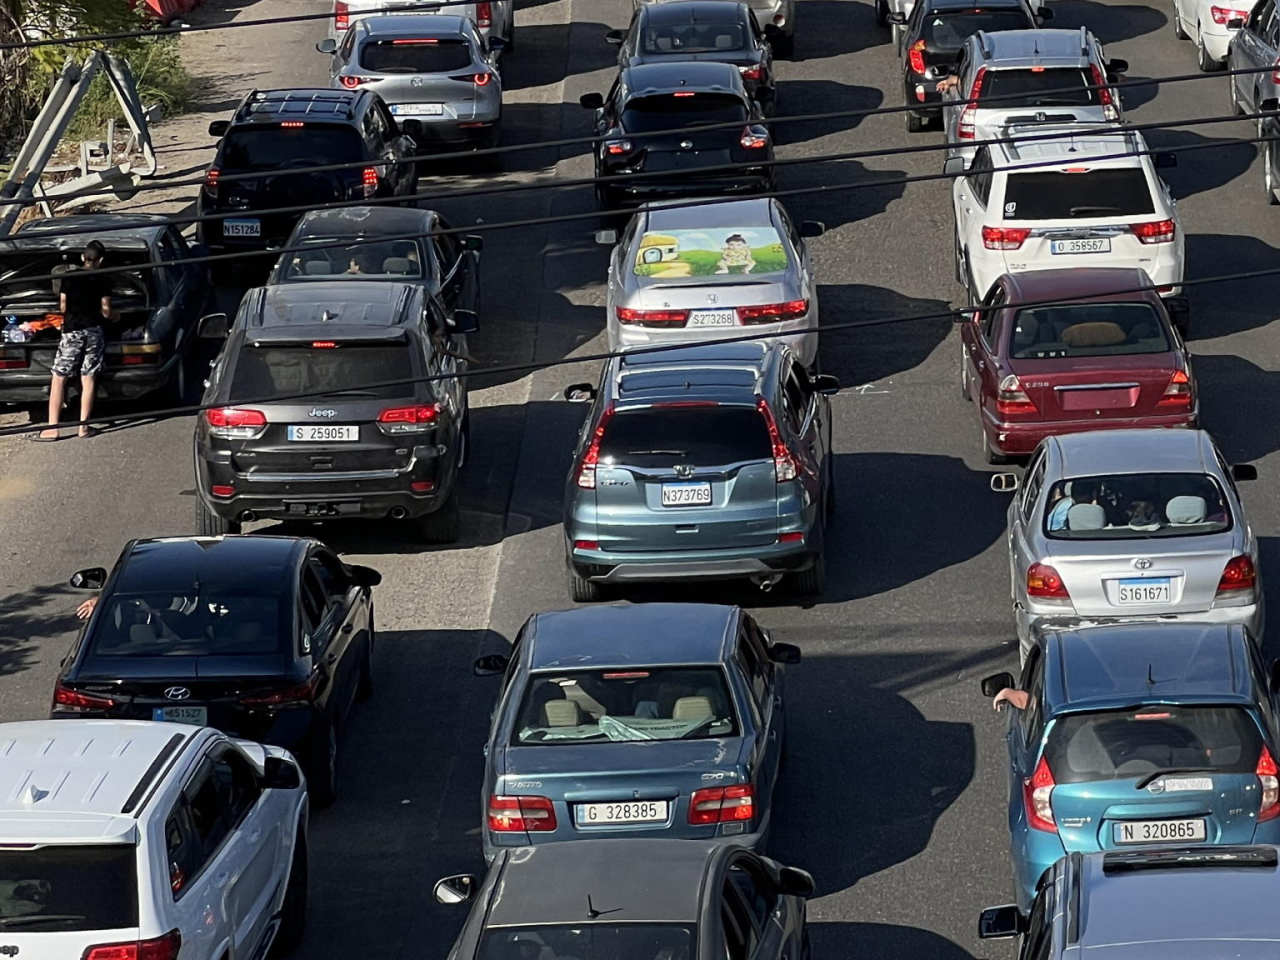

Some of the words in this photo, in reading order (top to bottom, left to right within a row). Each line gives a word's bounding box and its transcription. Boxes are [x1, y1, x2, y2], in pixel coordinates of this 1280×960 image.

[224, 224, 260, 235] N151284
[1069, 240, 1105, 252] 358567
[693, 314, 732, 326] S273268
[309, 408, 336, 418] Jeep
[297, 428, 303, 438] S
[311, 427, 350, 438] 259051
[663, 489, 711, 503] N373769
[1120, 587, 1168, 602] S161671
[589, 806, 597, 820] G
[606, 803, 657, 820] 328385
[1125, 824, 1134, 840] N
[1143, 821, 1195, 839] 320865
